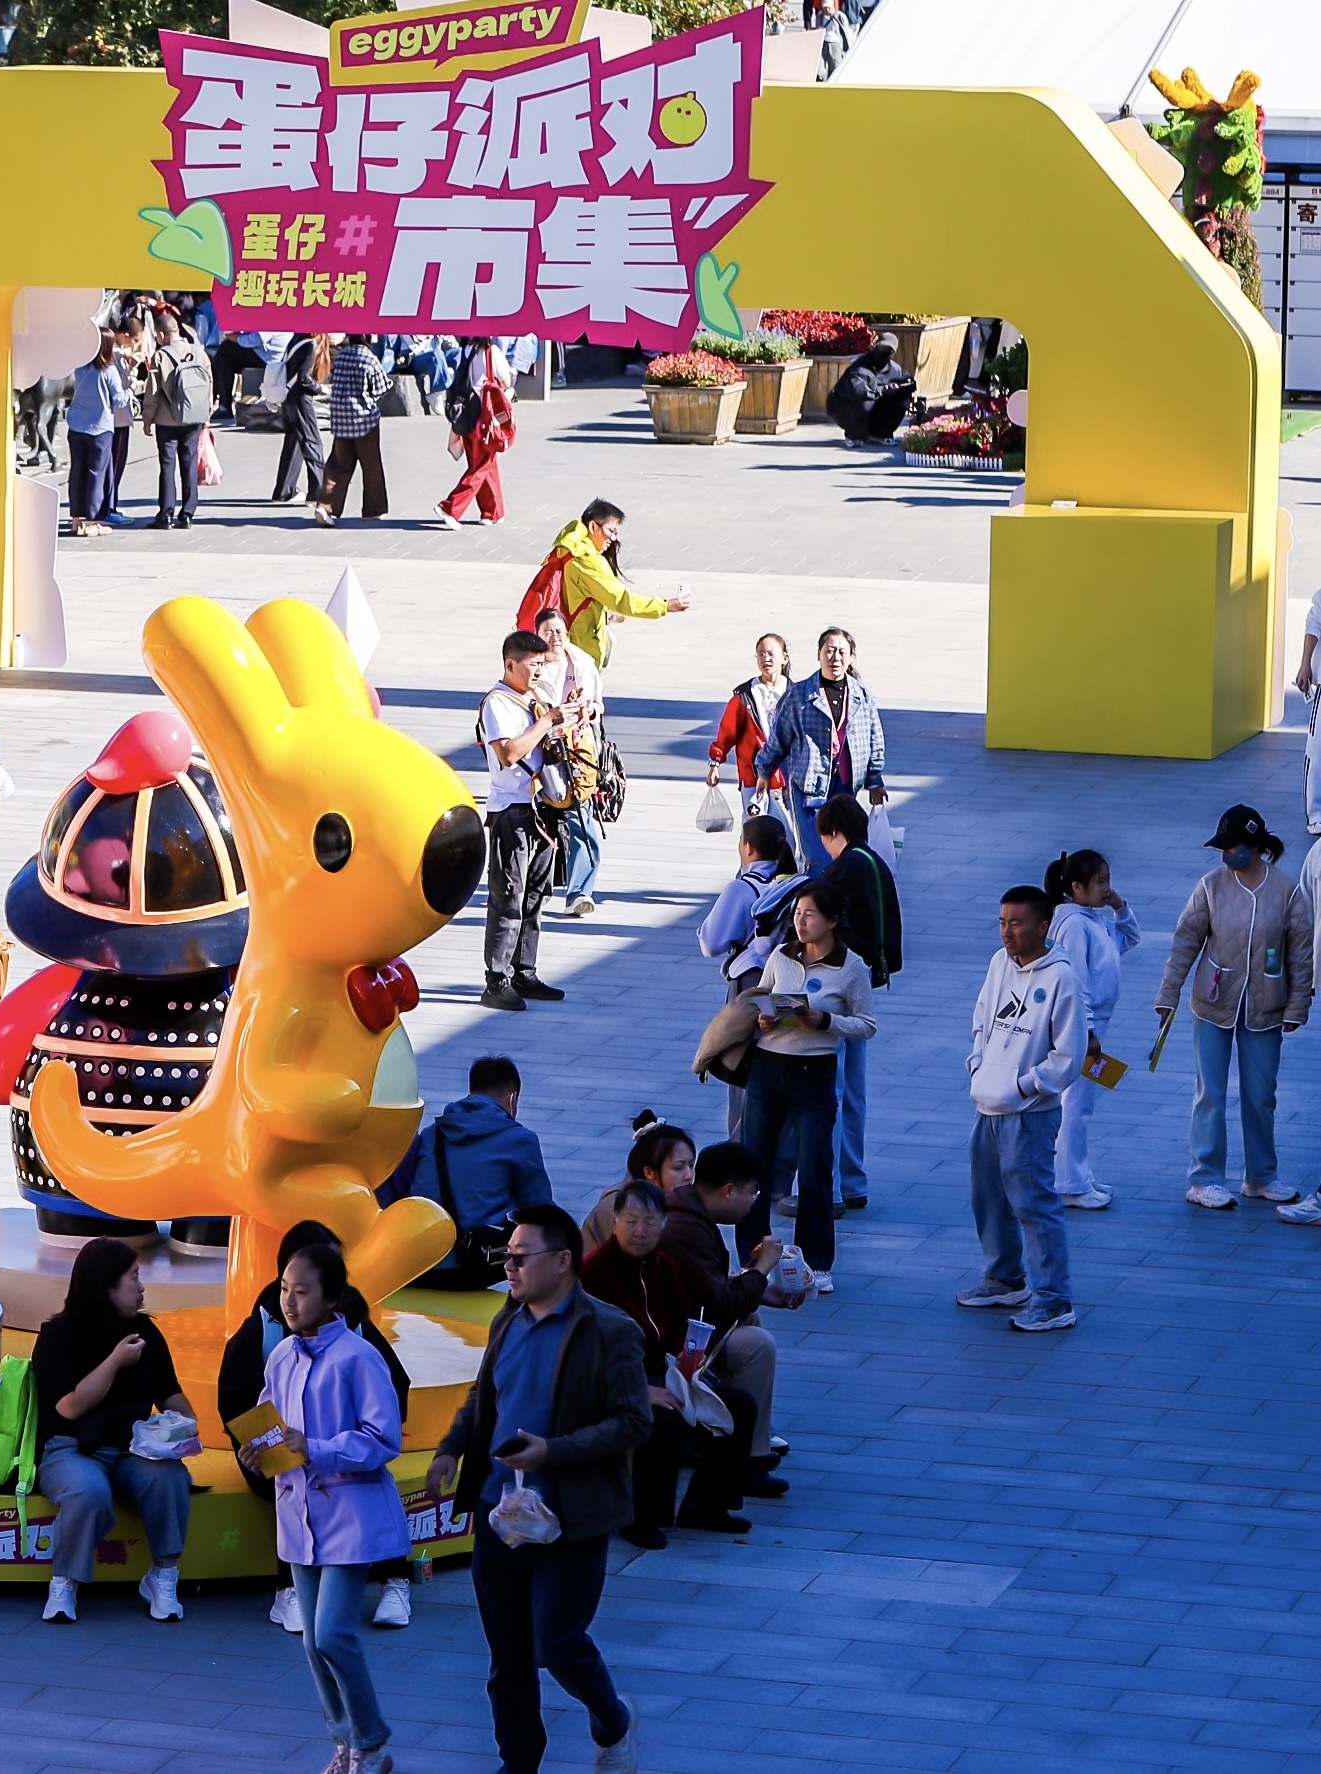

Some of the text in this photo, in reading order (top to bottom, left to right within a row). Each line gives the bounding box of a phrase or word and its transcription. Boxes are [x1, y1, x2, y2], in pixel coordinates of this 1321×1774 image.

[348, 6, 561, 60] eggyparty
[179, 33, 742, 199] 蛋仔派对
[241, 213, 326, 261] 蛋仔
[1297, 203, 1318, 224] 寄
[379, 195, 690, 327] 市集
[231, 270, 368, 308] 趣玩长城
